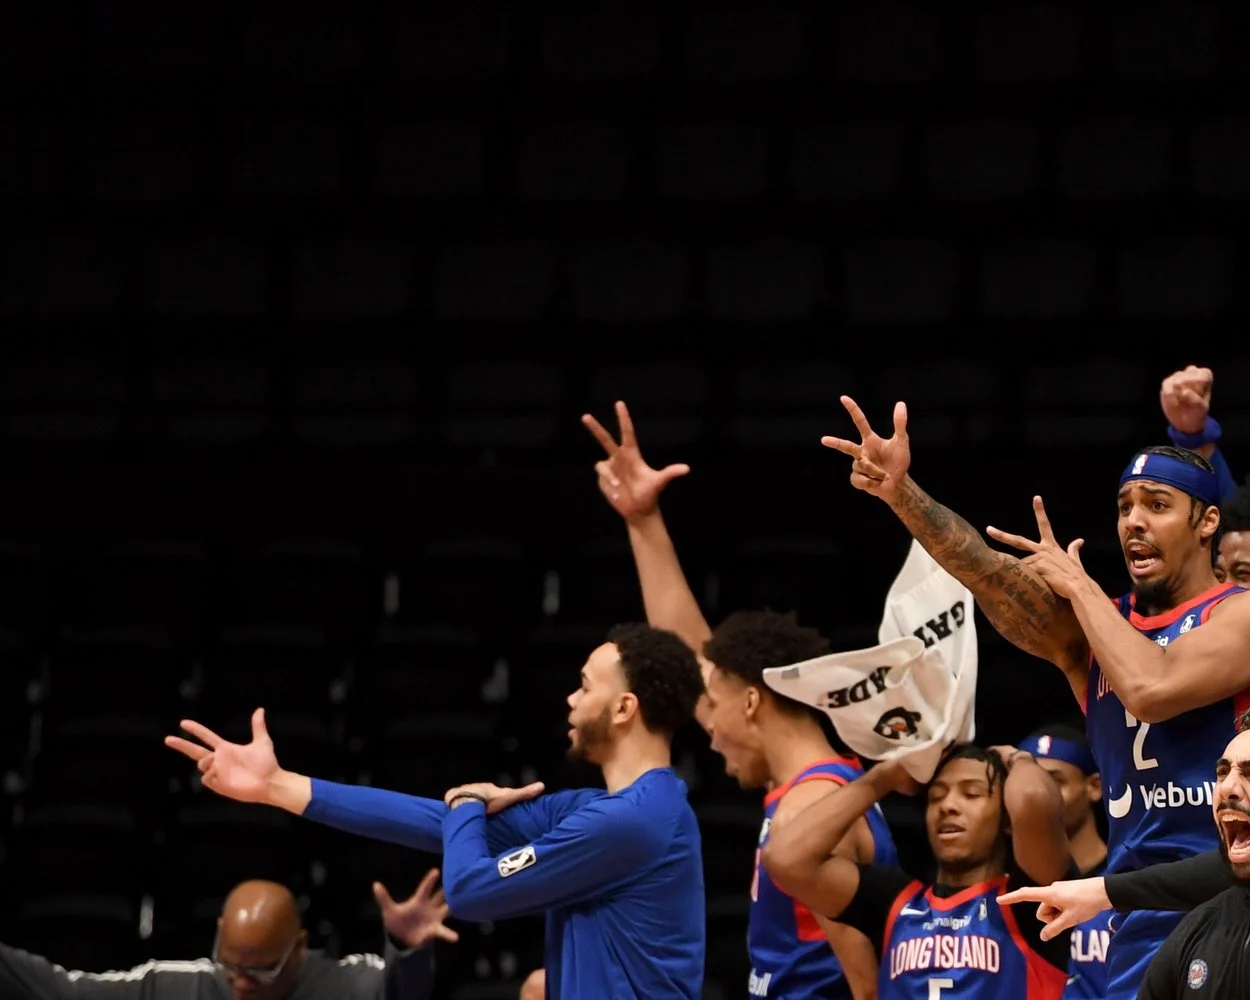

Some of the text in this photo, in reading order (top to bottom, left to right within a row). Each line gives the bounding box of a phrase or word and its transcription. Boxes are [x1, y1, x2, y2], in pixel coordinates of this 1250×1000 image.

[1125, 708, 1159, 771] 2
[890, 934, 1000, 981] LONG ISLAND
